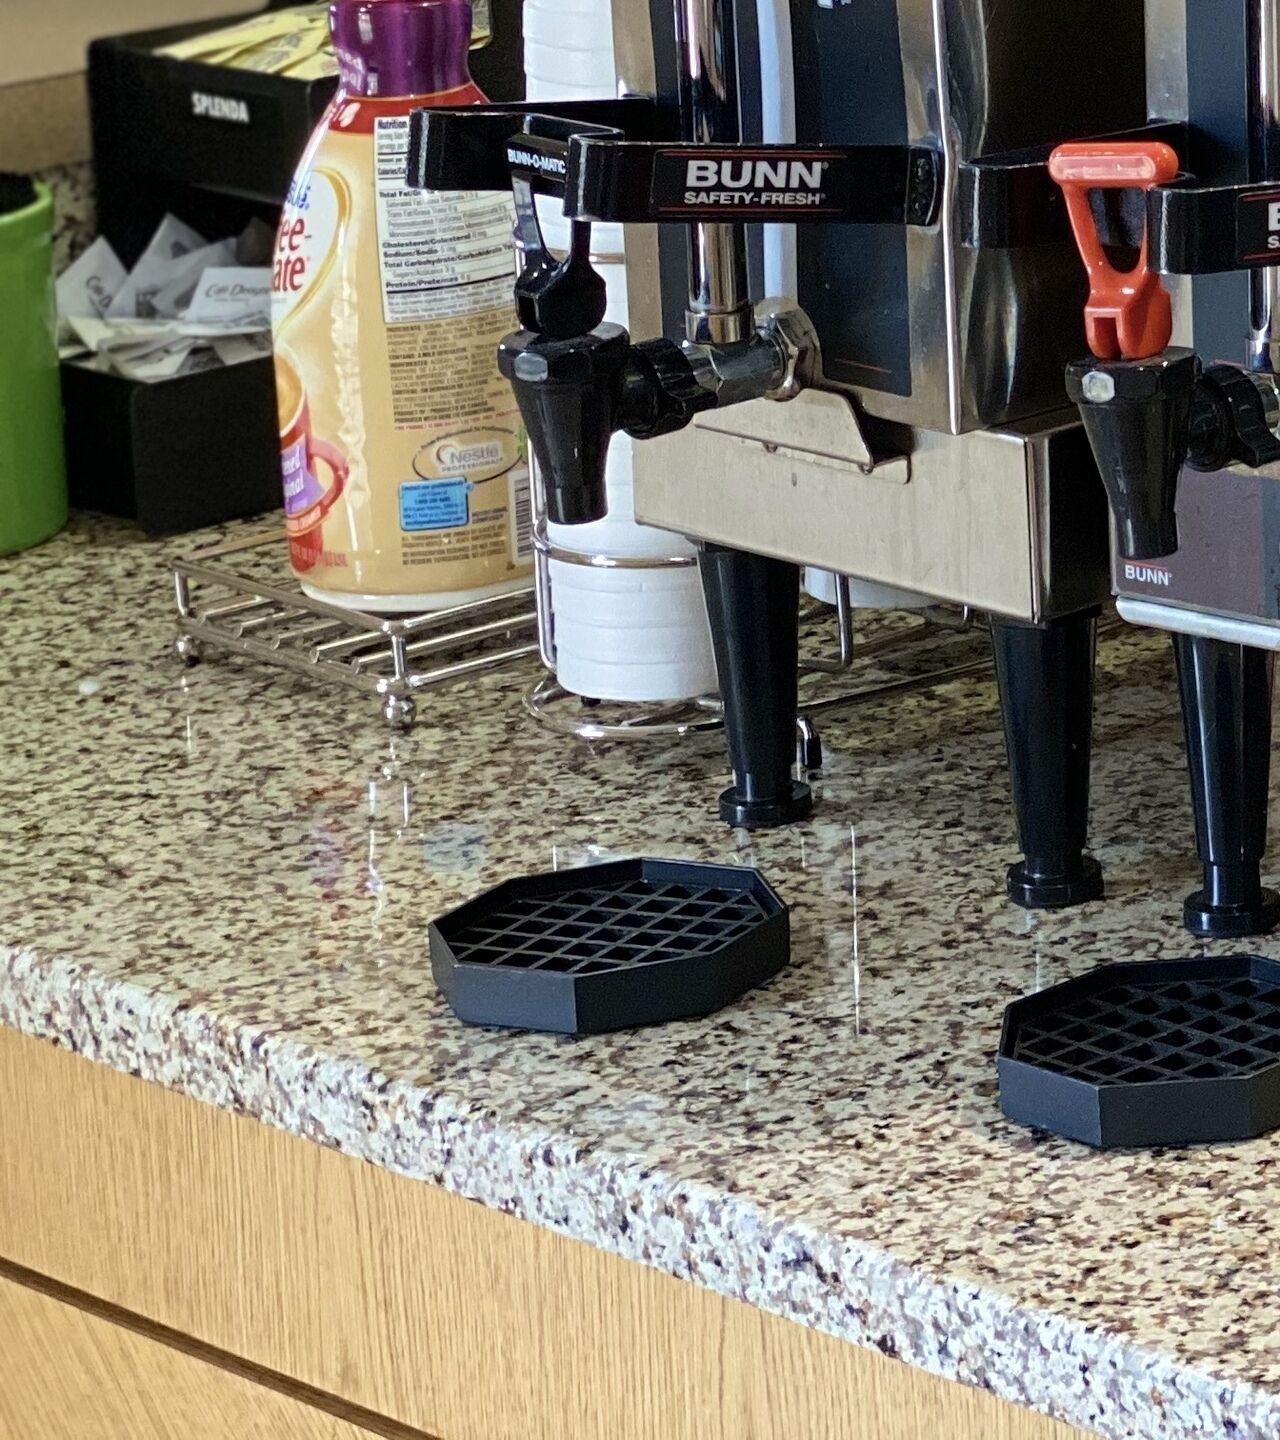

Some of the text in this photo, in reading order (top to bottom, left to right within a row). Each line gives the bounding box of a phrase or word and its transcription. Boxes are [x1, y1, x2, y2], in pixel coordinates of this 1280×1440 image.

[192, 91, 249, 123] SPLENDA
[377, 119, 408, 129] Nutrition
[507, 148, 567, 174] BUNN-O-MATIC
[686, 160, 823, 189] BUNN
[683, 191, 821, 205] SAFETY-FRESH
[382, 233, 471, 249] Cholesterol/Colesterol
[383, 248, 438, 259] Sodium/Sodio
[272, 254, 306, 292] ate
[384, 261, 403, 269] Total
[1125, 564, 1169, 586] BUNN
